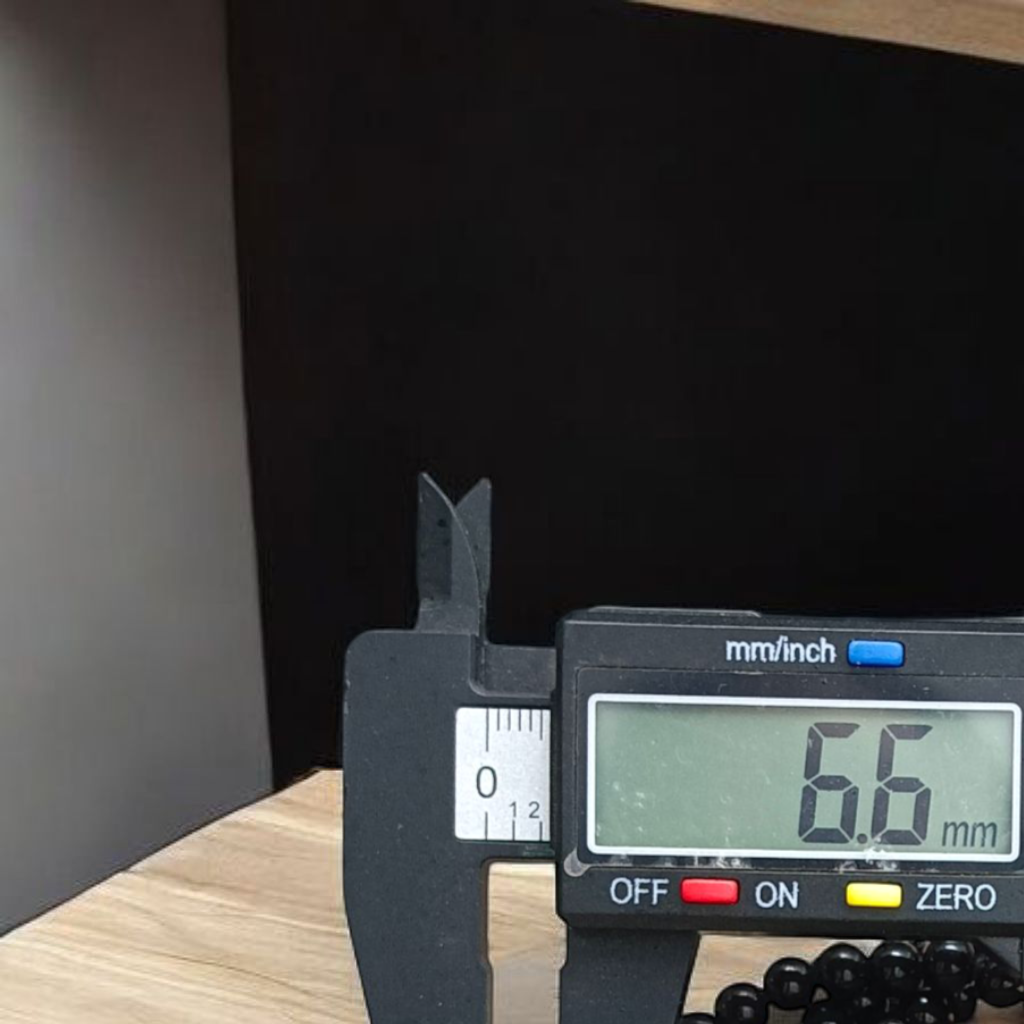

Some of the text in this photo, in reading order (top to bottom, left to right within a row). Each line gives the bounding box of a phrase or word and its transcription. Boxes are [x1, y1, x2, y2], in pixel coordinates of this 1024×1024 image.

[725, 635, 837, 664] mm/inch
[476, 765, 498, 799] 0
[798, 722, 998, 848] 6.6 mm
[609, 877, 997, 912] OFF ON ZERO
